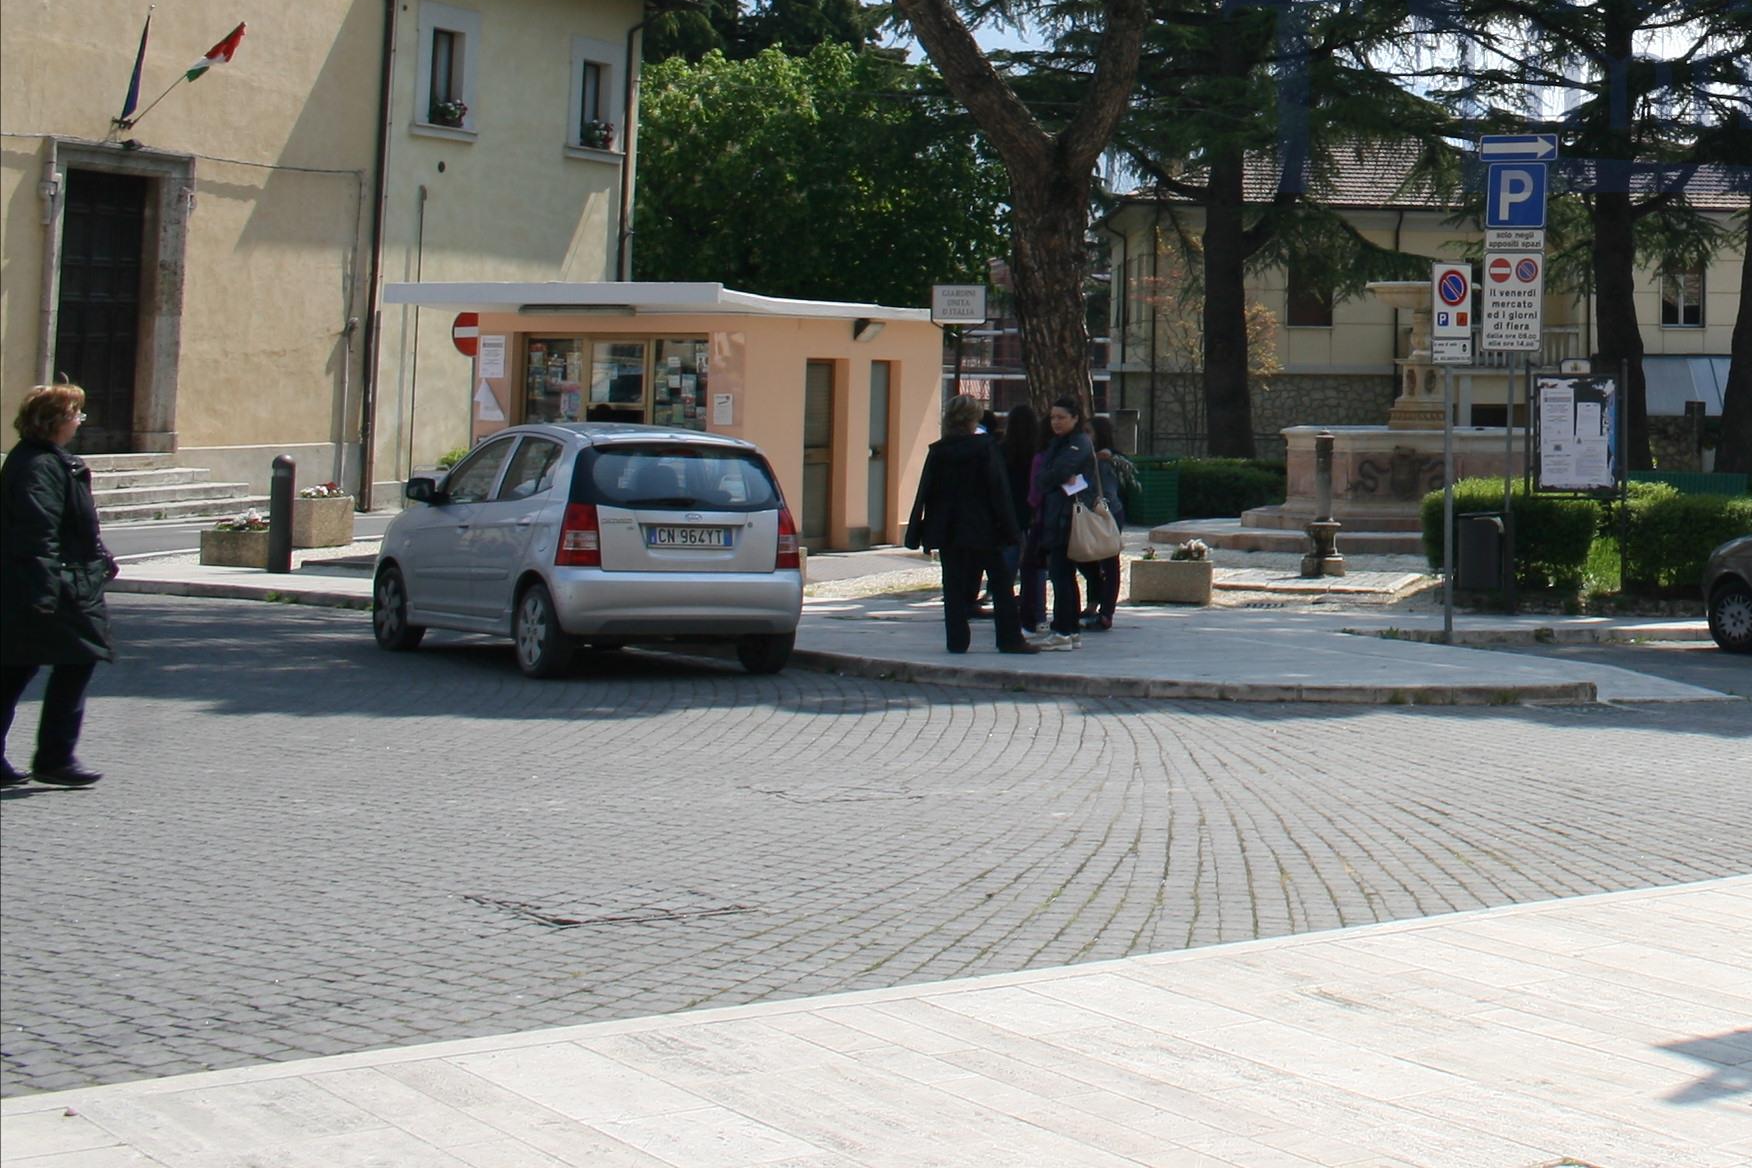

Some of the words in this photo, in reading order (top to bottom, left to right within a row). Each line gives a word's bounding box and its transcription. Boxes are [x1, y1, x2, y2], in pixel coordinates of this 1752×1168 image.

[1499, 169, 1534, 221] P
[1488, 240, 1519, 248] appositi
[1521, 240, 1541, 248] spazi
[1491, 300, 1533, 308] mercato
[1439, 313, 1447, 325] P
[1487, 310, 1499, 319] ed
[1508, 311, 1538, 321] giorni
[1493, 321, 1503, 330] di
[1506, 321, 1530, 330] fiera
[657, 528, 675, 544] CN
